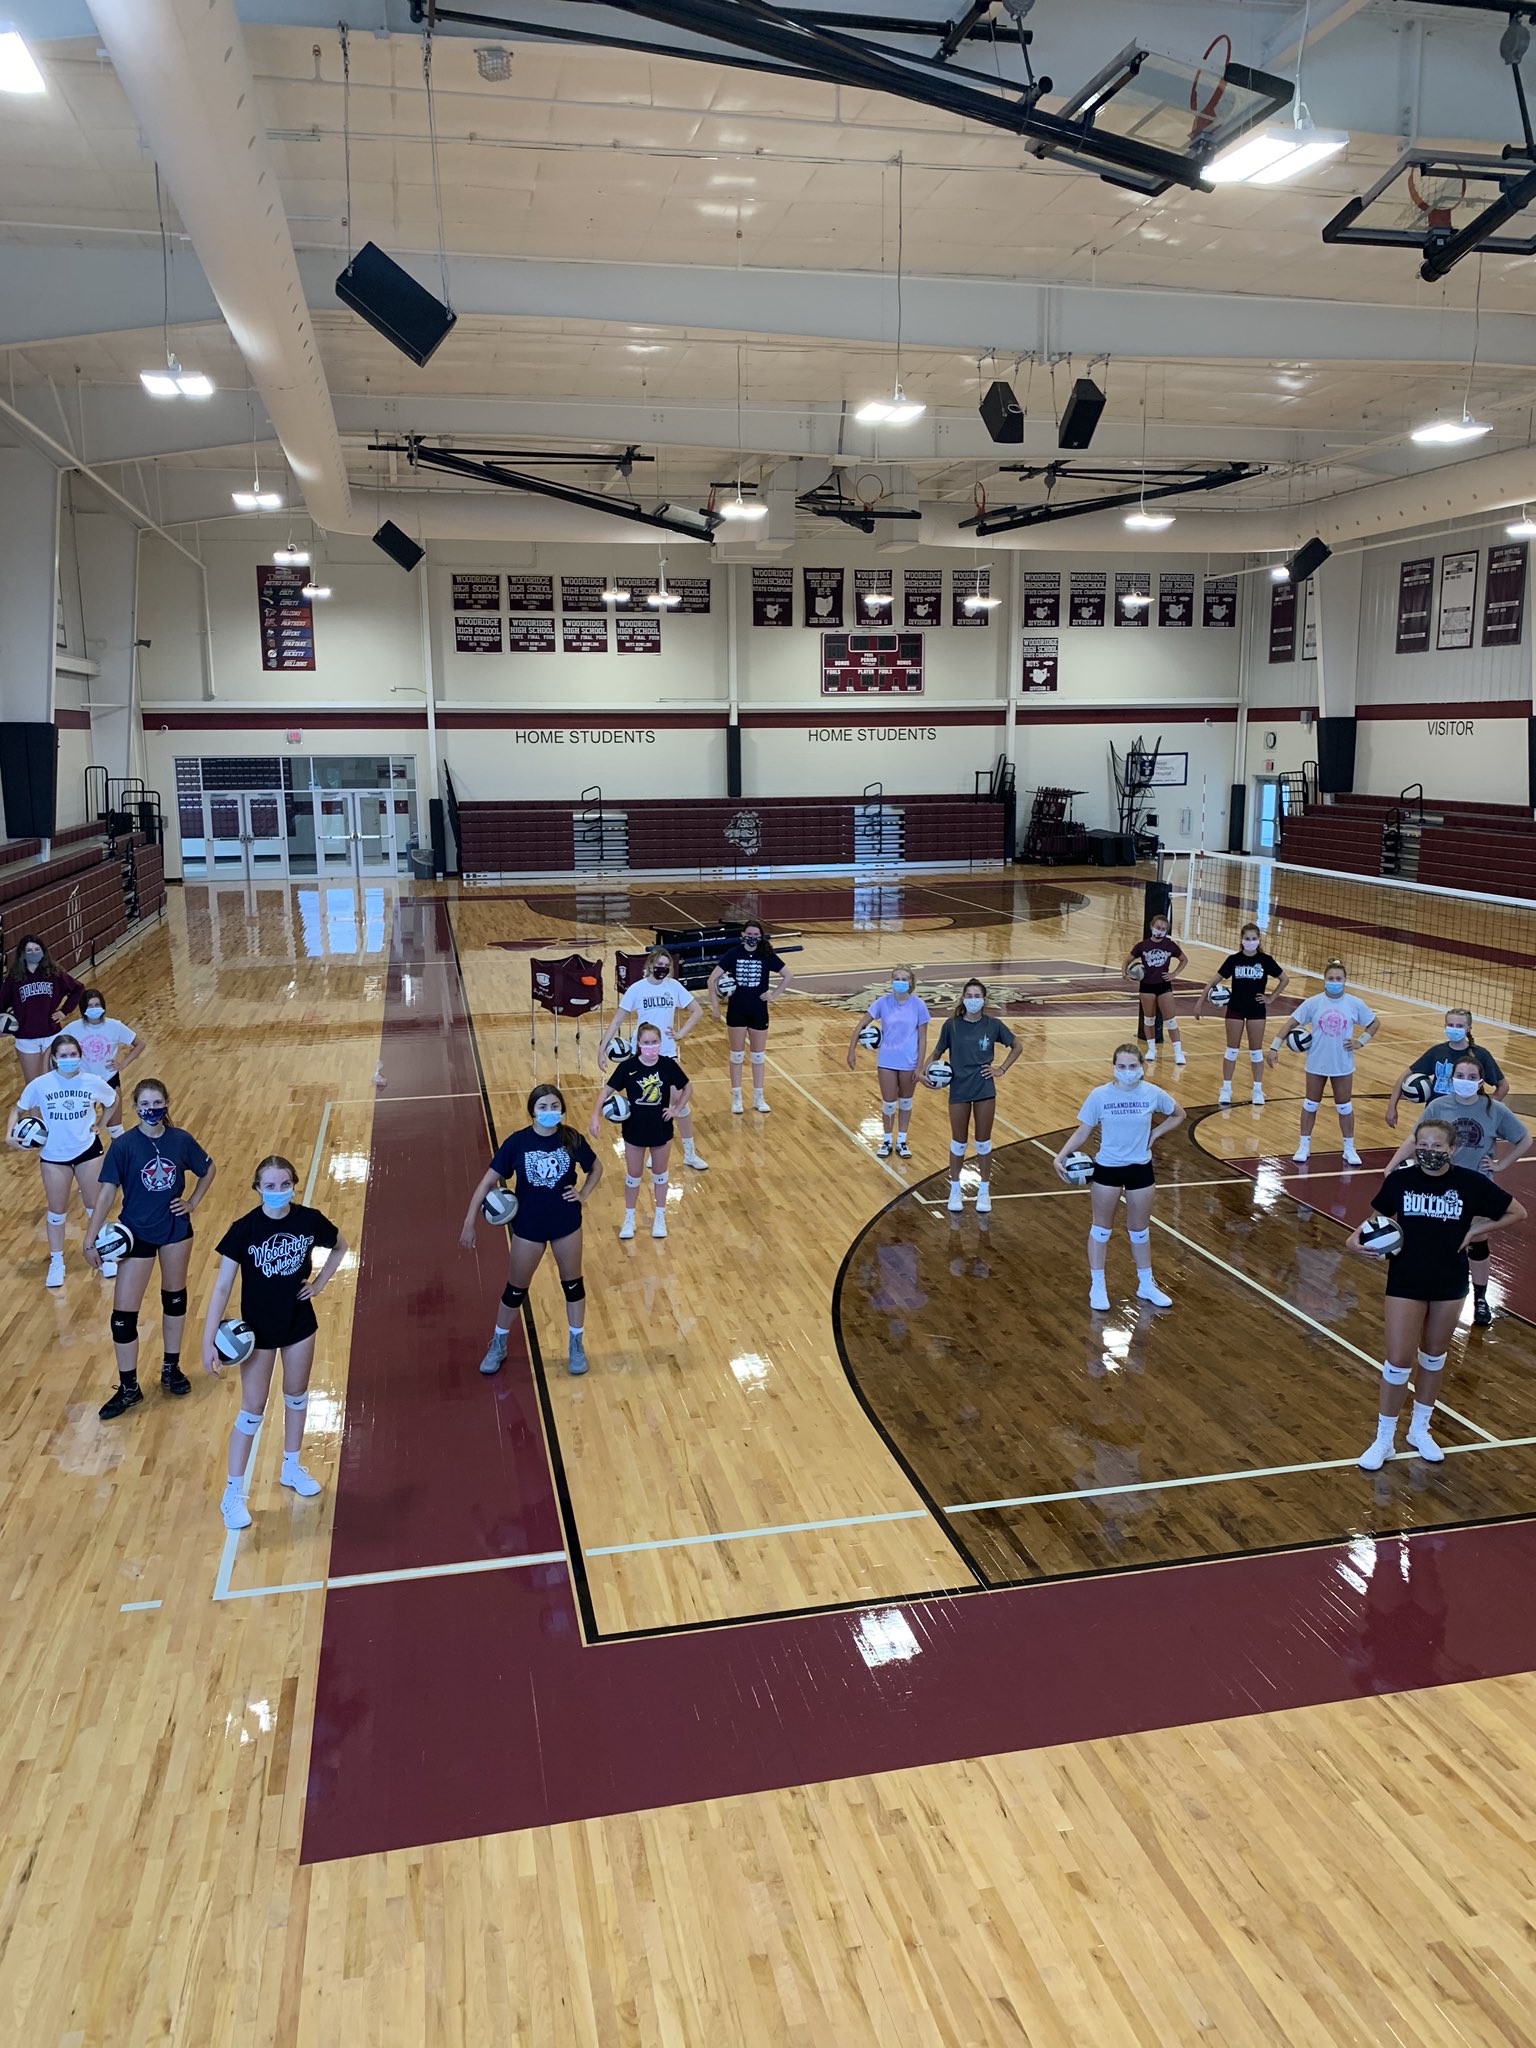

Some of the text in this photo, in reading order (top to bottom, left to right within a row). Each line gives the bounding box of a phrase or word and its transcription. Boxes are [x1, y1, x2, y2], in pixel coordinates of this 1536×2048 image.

[458, 618, 499, 626] WOODRIDGE
[474, 627, 502, 635] SCHOOL
[1428, 721, 1474, 735] VISITOR
[516, 731, 656, 743] HOME STUDENTS
[809, 728, 937, 741] HOME STUDENTS
[45, 1090, 92, 1101] WOODRIDGE
[50, 1109, 88, 1120] BULLDOGS
[1404, 1196, 1463, 1216] BULLDOG
[248, 1234, 315, 1268] Woodridge
[262, 1254, 301, 1278] Bulldogs
